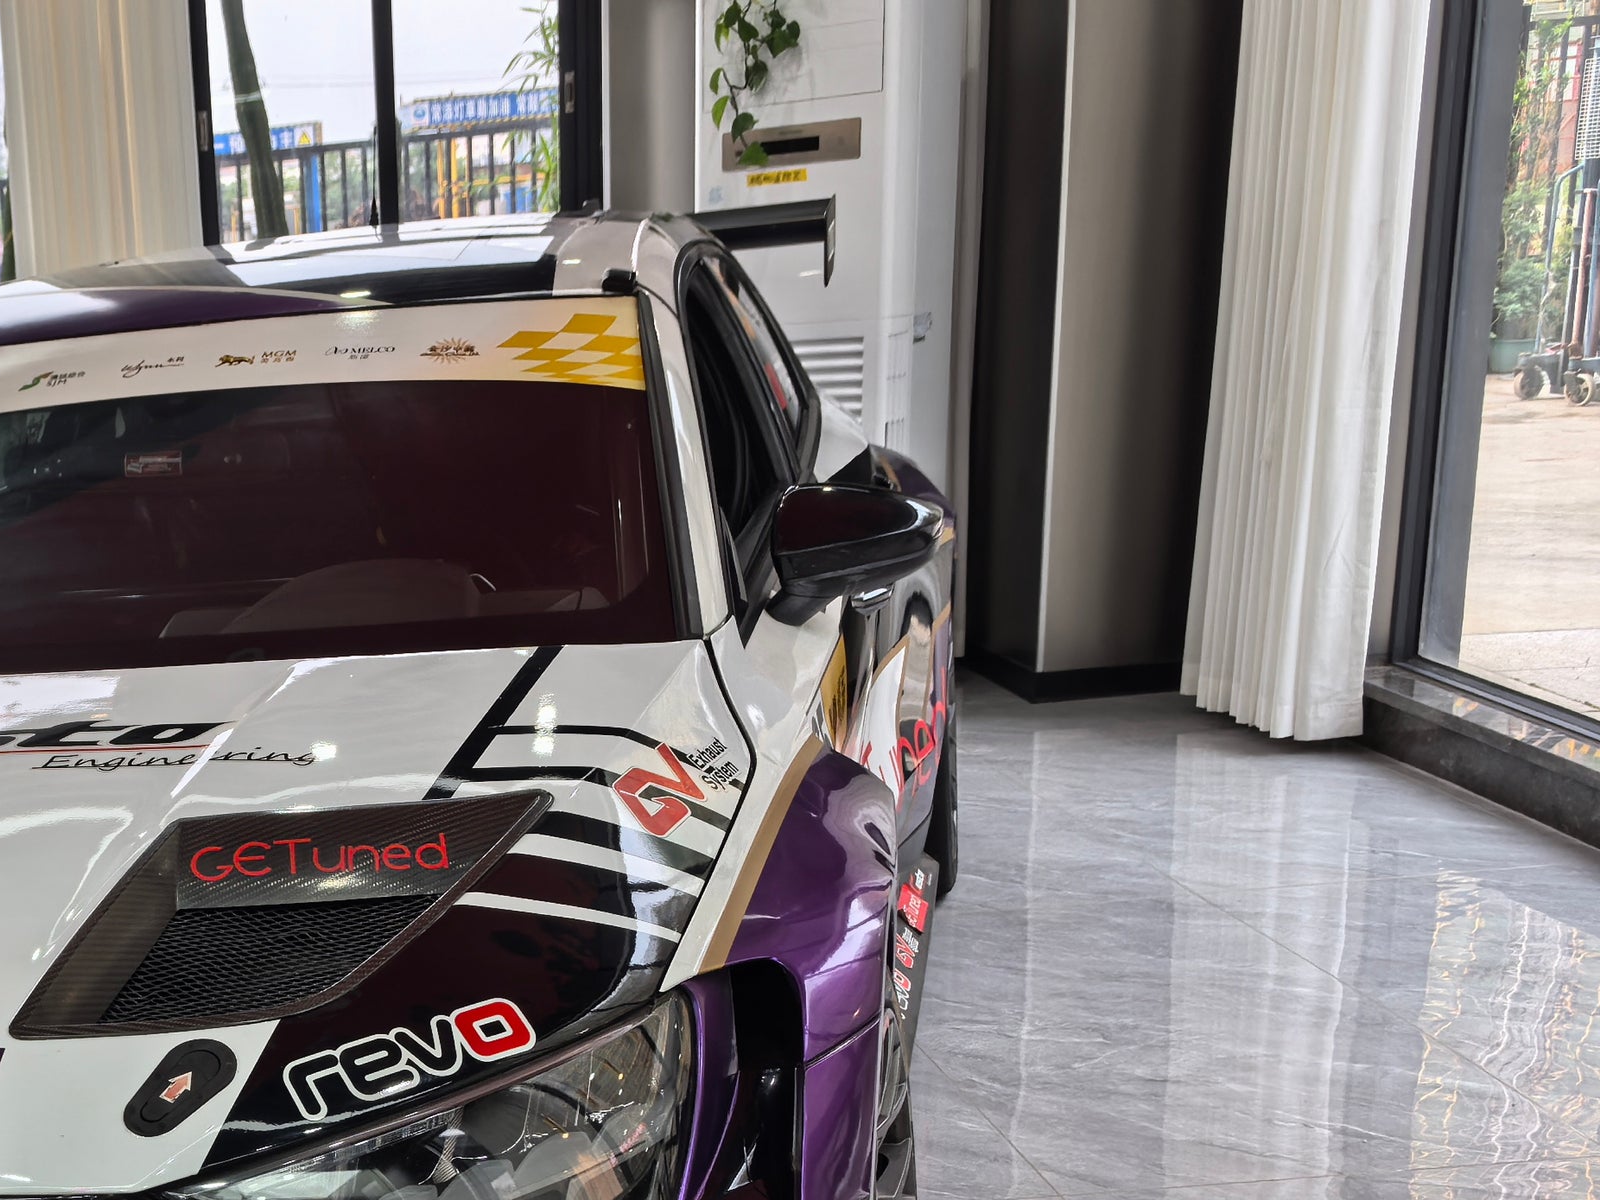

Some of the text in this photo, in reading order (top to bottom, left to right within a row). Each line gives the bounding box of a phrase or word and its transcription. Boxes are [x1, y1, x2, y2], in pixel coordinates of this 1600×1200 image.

[261, 350, 297, 358] MGM
[40, 746, 316, 772] Enginering
[688, 737, 728, 769] Exhaust
[702, 761, 740, 790] System
[190, 833, 449, 882] GETuned
[282, 998, 537, 1122] revo
